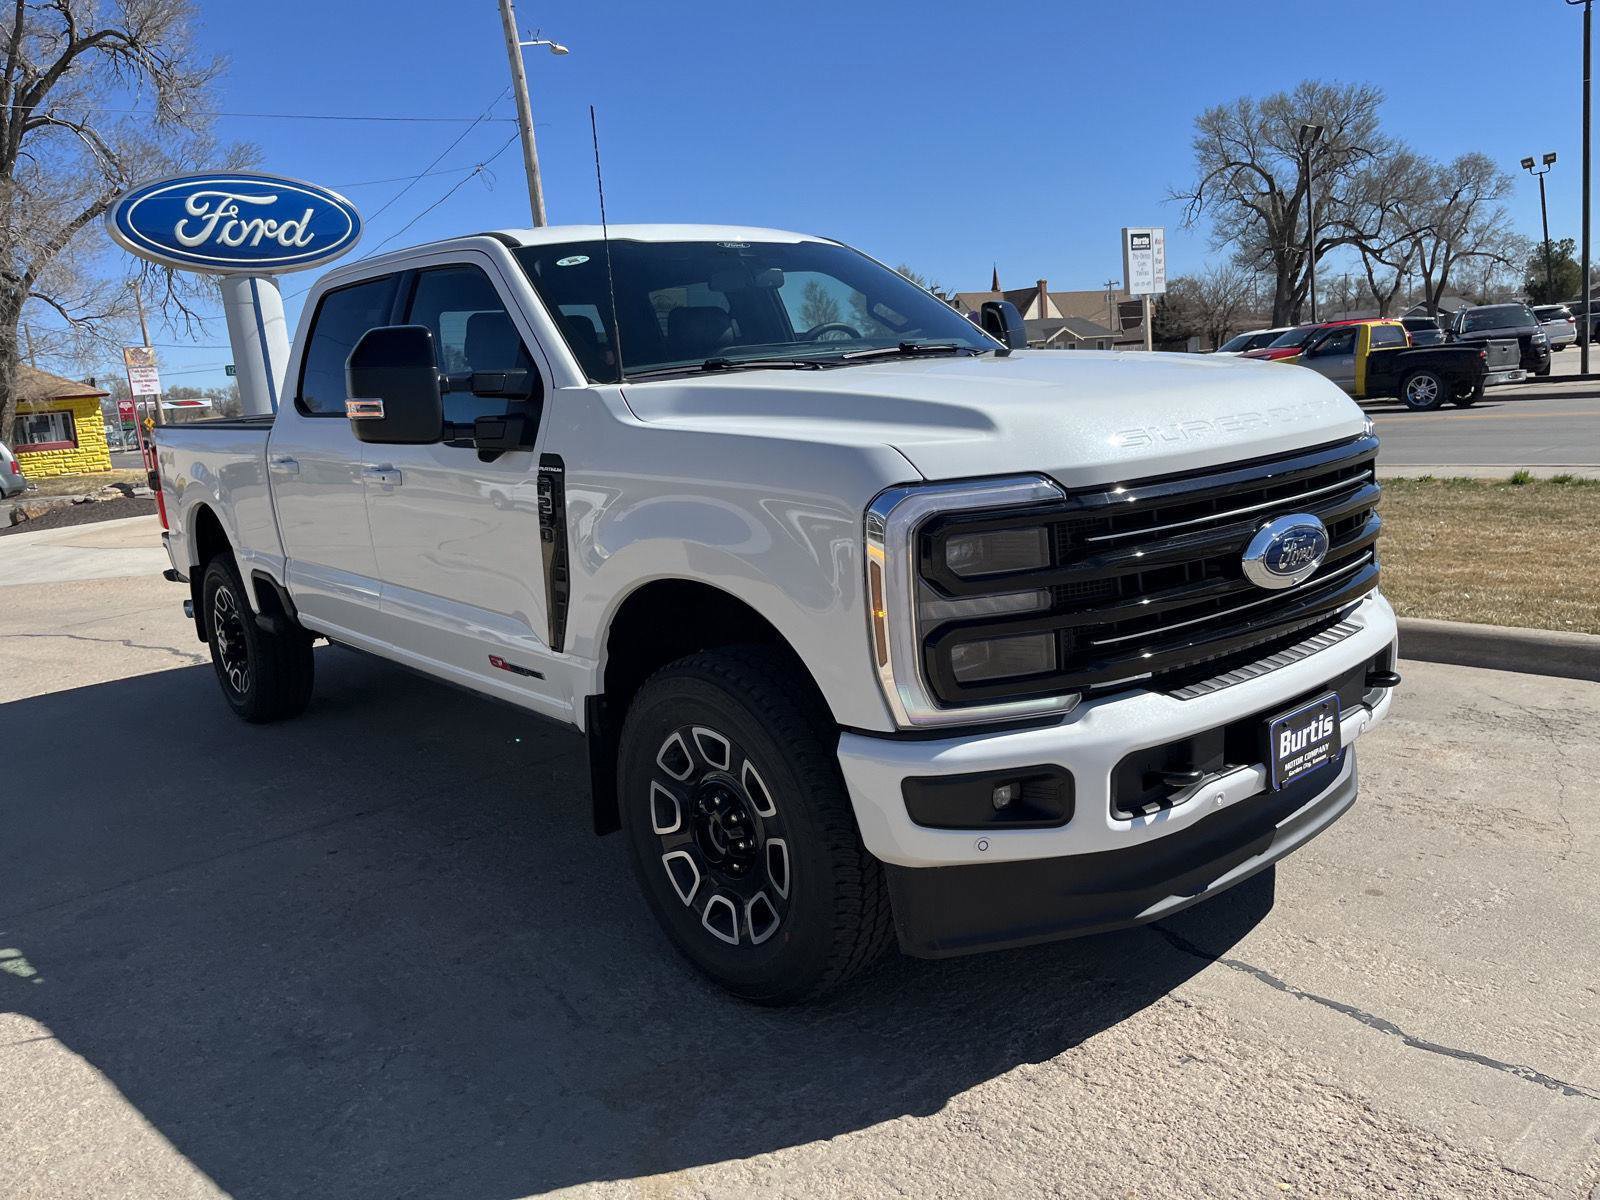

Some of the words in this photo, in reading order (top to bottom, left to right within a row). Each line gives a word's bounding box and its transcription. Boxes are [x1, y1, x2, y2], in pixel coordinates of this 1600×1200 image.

[174, 190, 315, 248] Ford
[1116, 411, 1271, 449] SUPER
[1279, 534, 1316, 569] Ford
[1280, 714, 1333, 759] Burtis
[1284, 755, 1304, 771] MOTOR
[1304, 742, 1330, 761] COMPANY
